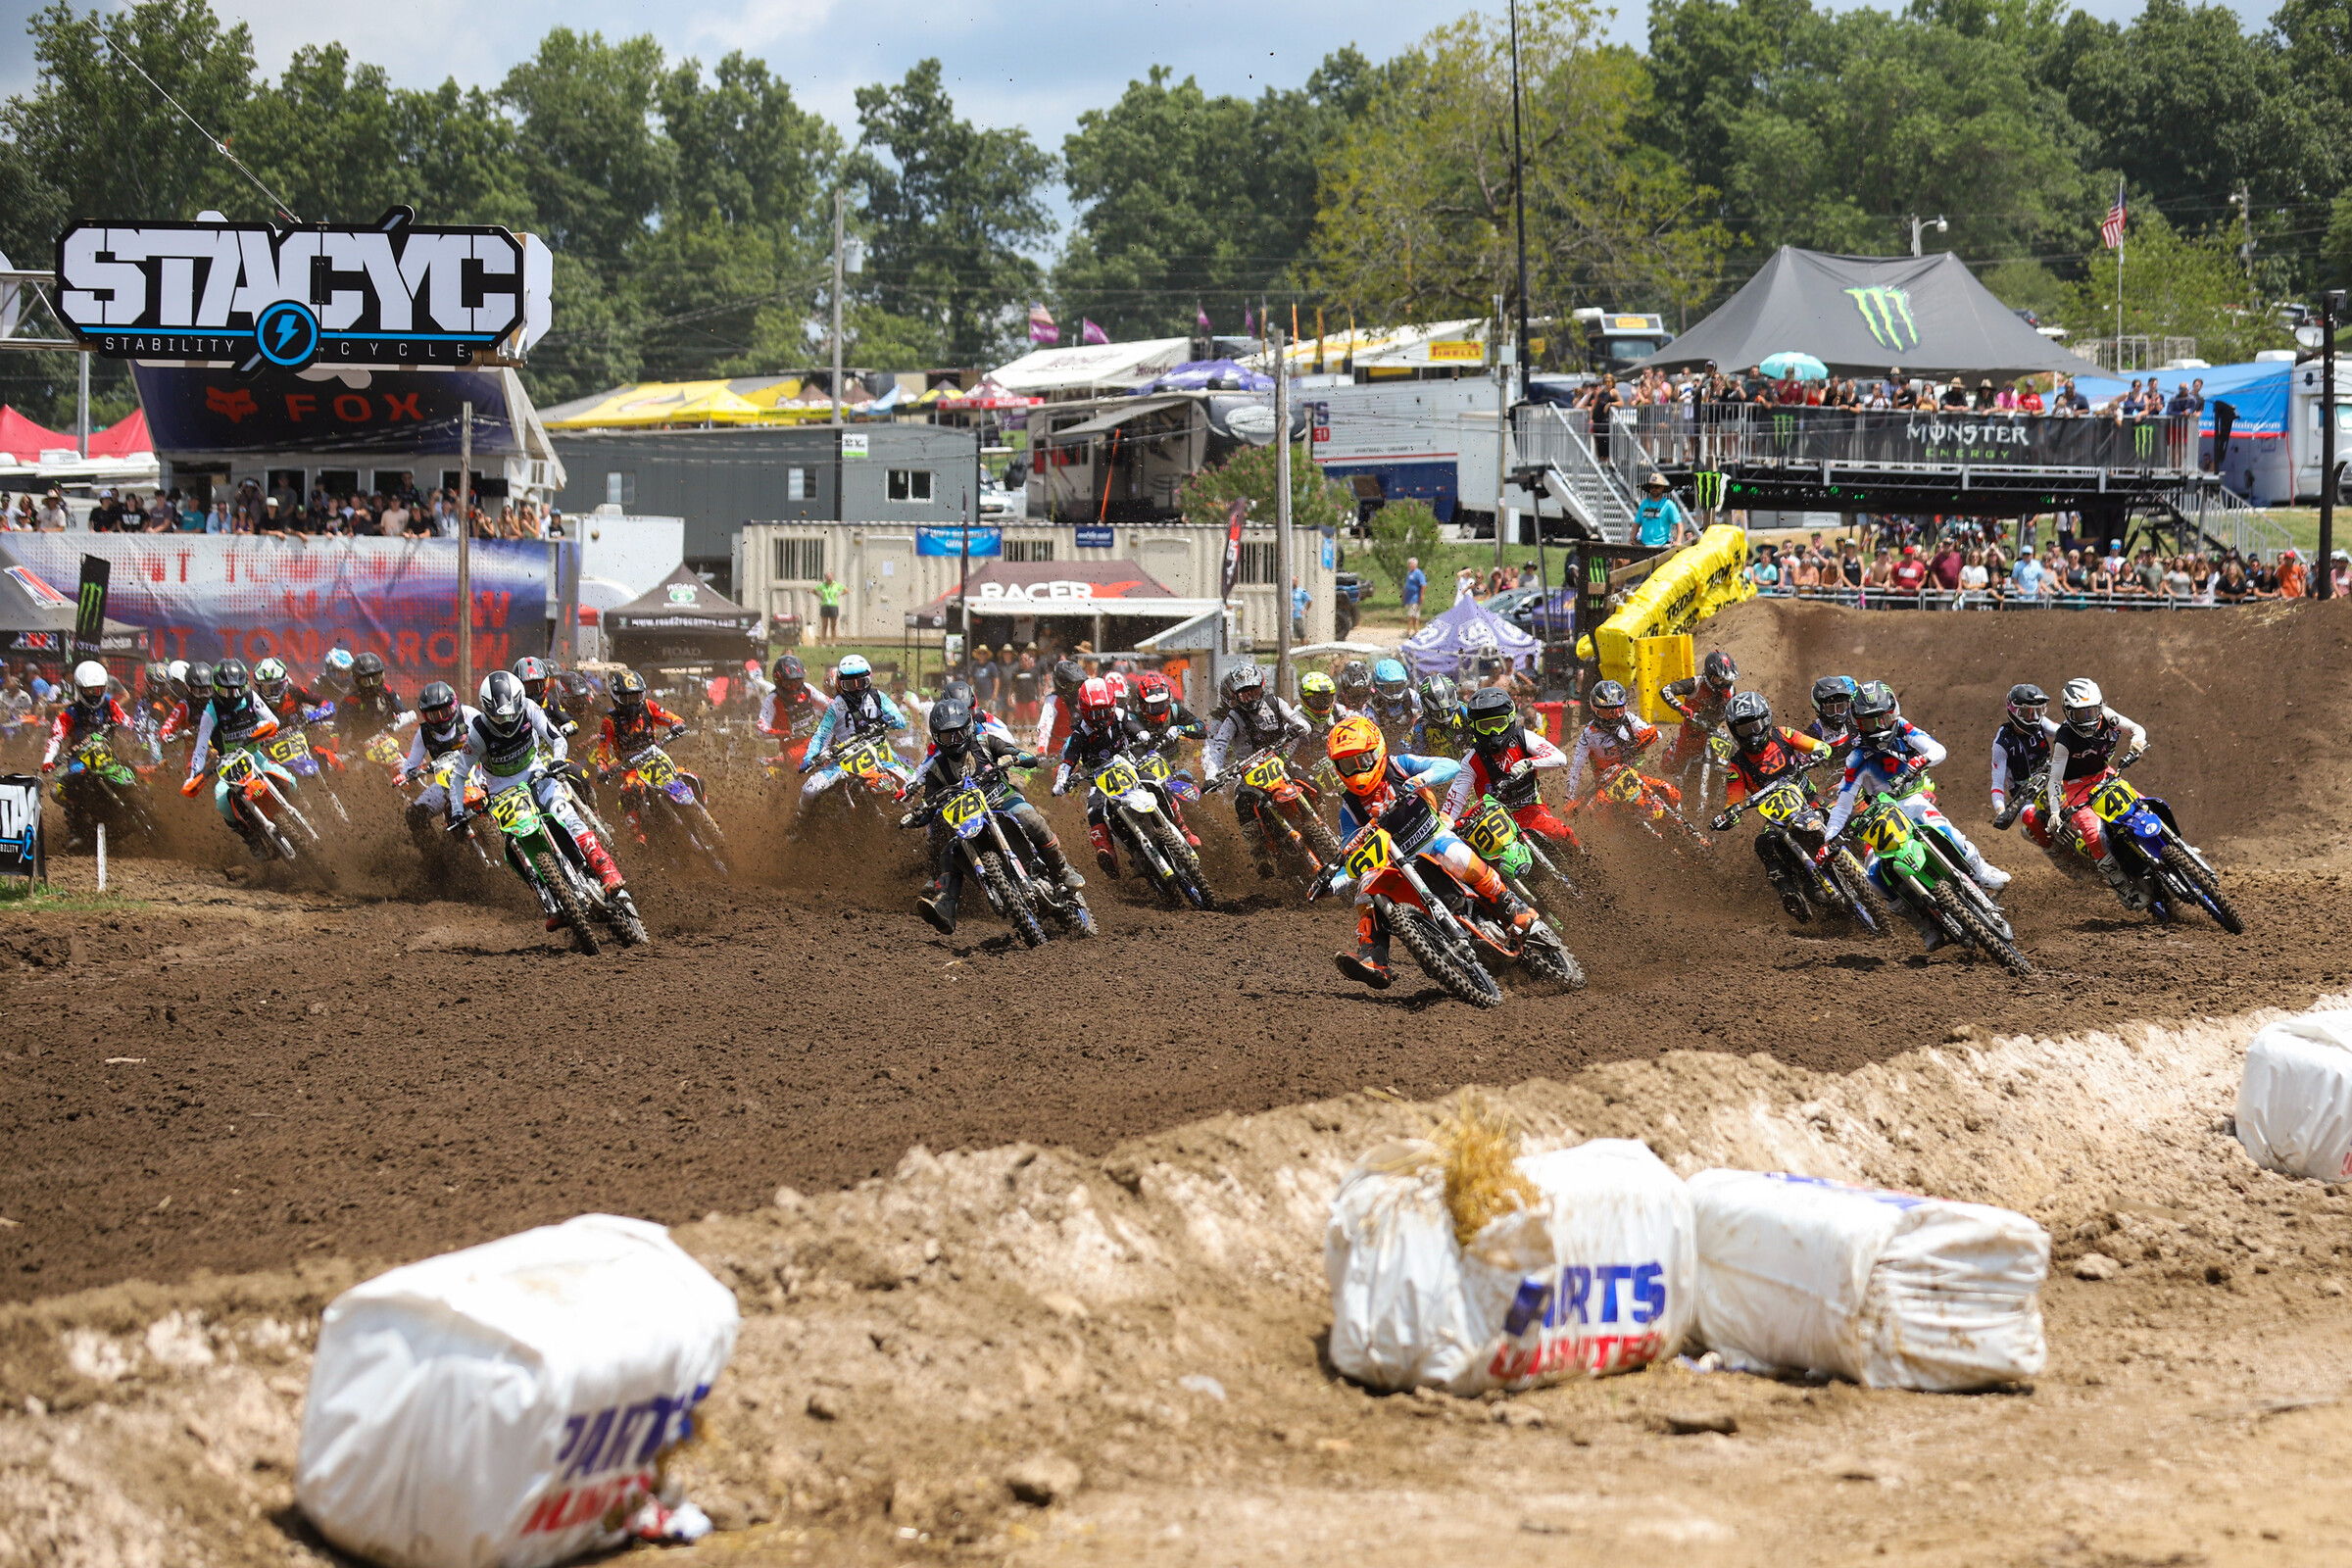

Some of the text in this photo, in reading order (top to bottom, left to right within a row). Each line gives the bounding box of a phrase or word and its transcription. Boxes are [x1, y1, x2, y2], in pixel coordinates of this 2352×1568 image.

[62, 226, 516, 332] STACYC
[105, 337, 467, 358] STABILITY CYCLE
[286, 394, 425, 422] FOX
[1926, 447, 2009, 460] ENERGY
[843, 748, 876, 774] 73
[1253, 762, 1283, 787] 90
[1104, 763, 1135, 795] 43
[498, 792, 533, 828] 24
[947, 794, 982, 825] 78
[1765, 791, 1799, 820] 30
[2104, 786, 2135, 818] 41
[1473, 812, 1511, 854] 99
[1869, 807, 1907, 852] 21
[1349, 834, 1385, 878] 67
